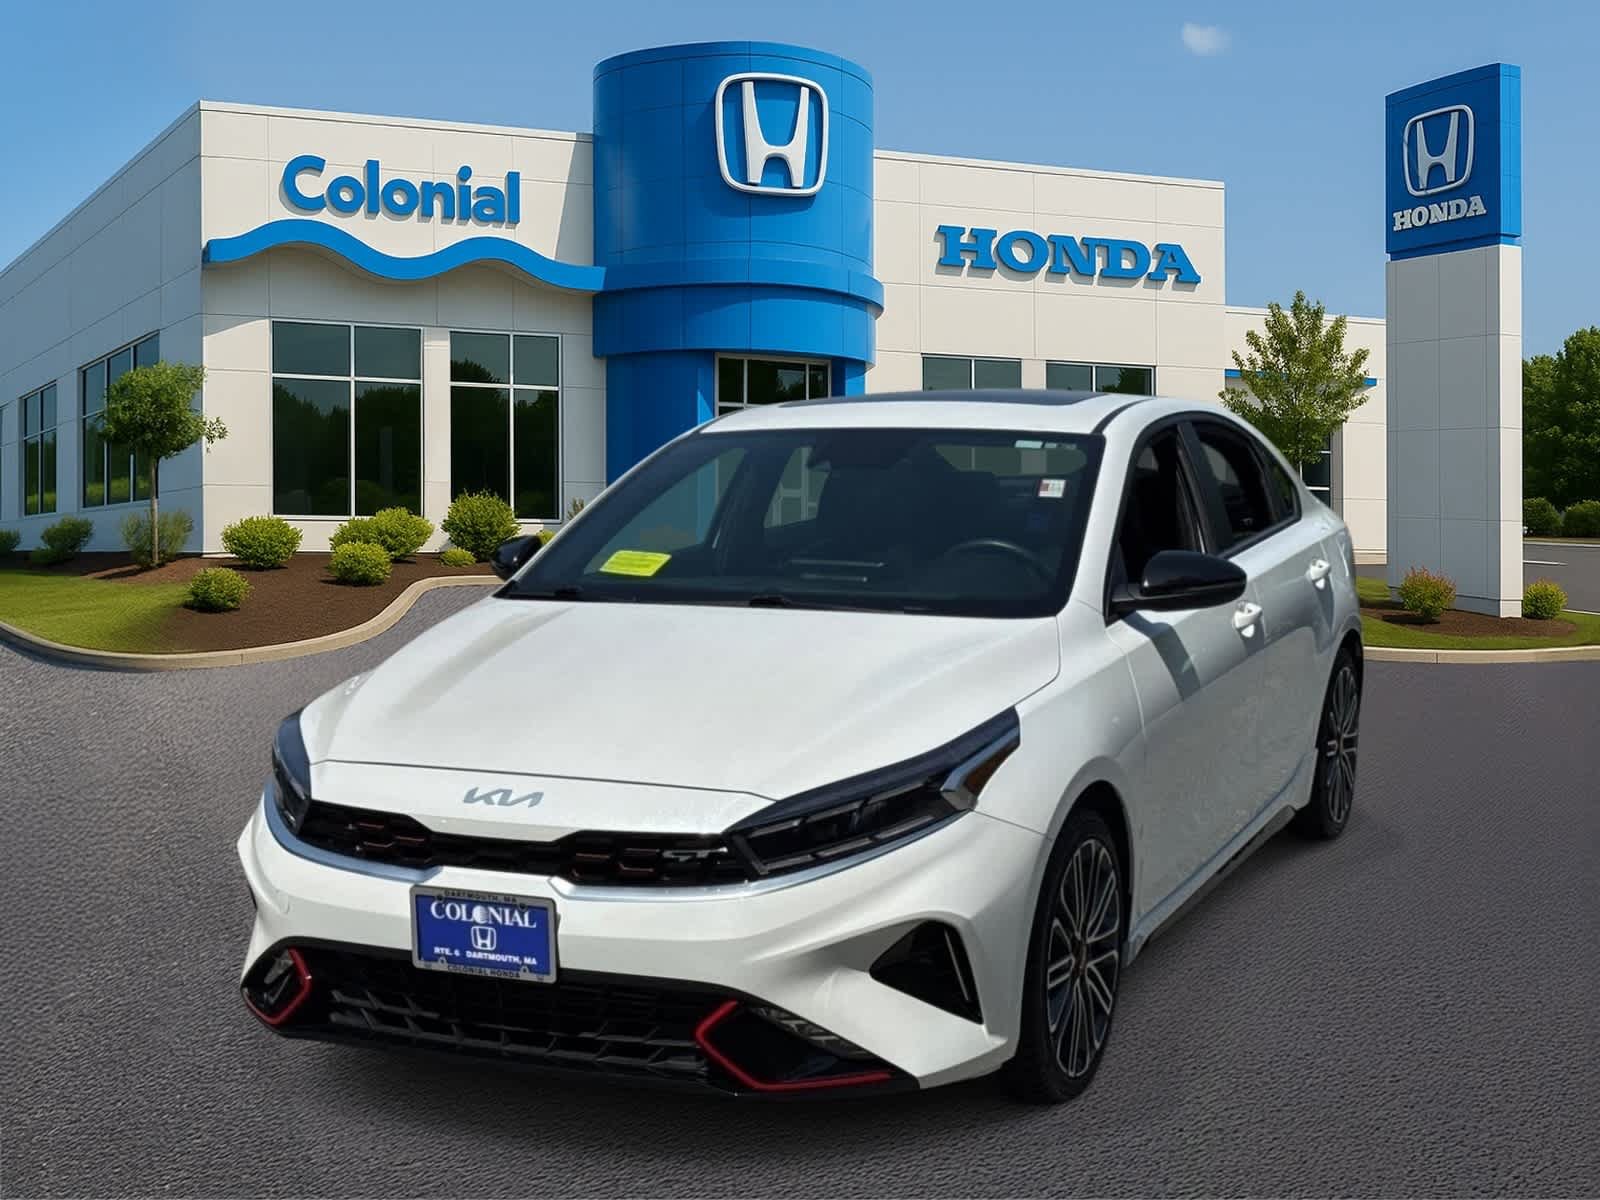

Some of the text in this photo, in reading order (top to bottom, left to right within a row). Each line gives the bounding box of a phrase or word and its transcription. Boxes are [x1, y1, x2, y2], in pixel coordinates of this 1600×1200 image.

[280, 154, 521, 227] Colonial
[1393, 195, 1487, 232] HONDA
[935, 224, 1202, 288] HONDA
[430, 901, 537, 928] COLONIAL
[465, 950, 523, 965] DARTMOUTH,
[523, 956, 538, 966] MA
